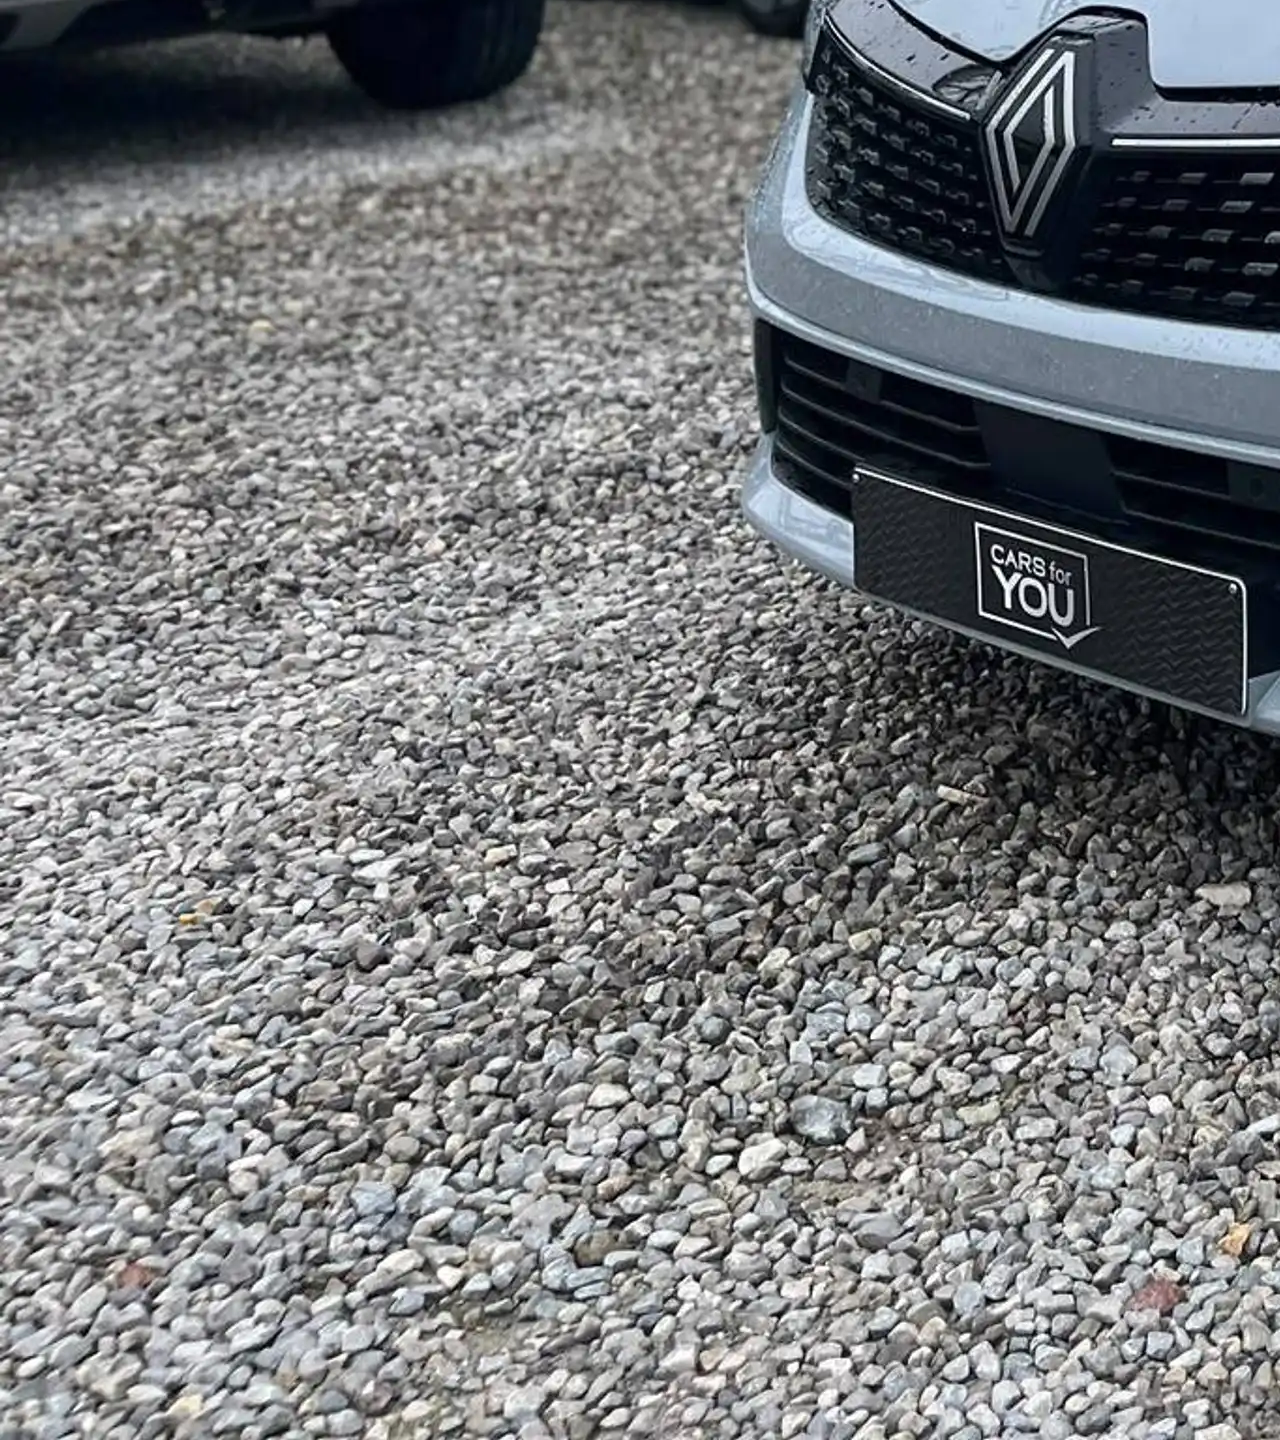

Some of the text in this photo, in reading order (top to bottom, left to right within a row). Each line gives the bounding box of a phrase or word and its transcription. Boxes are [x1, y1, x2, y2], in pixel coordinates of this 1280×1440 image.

[990, 543, 1073, 586] CARS for
[991, 564, 1074, 627] YOU
